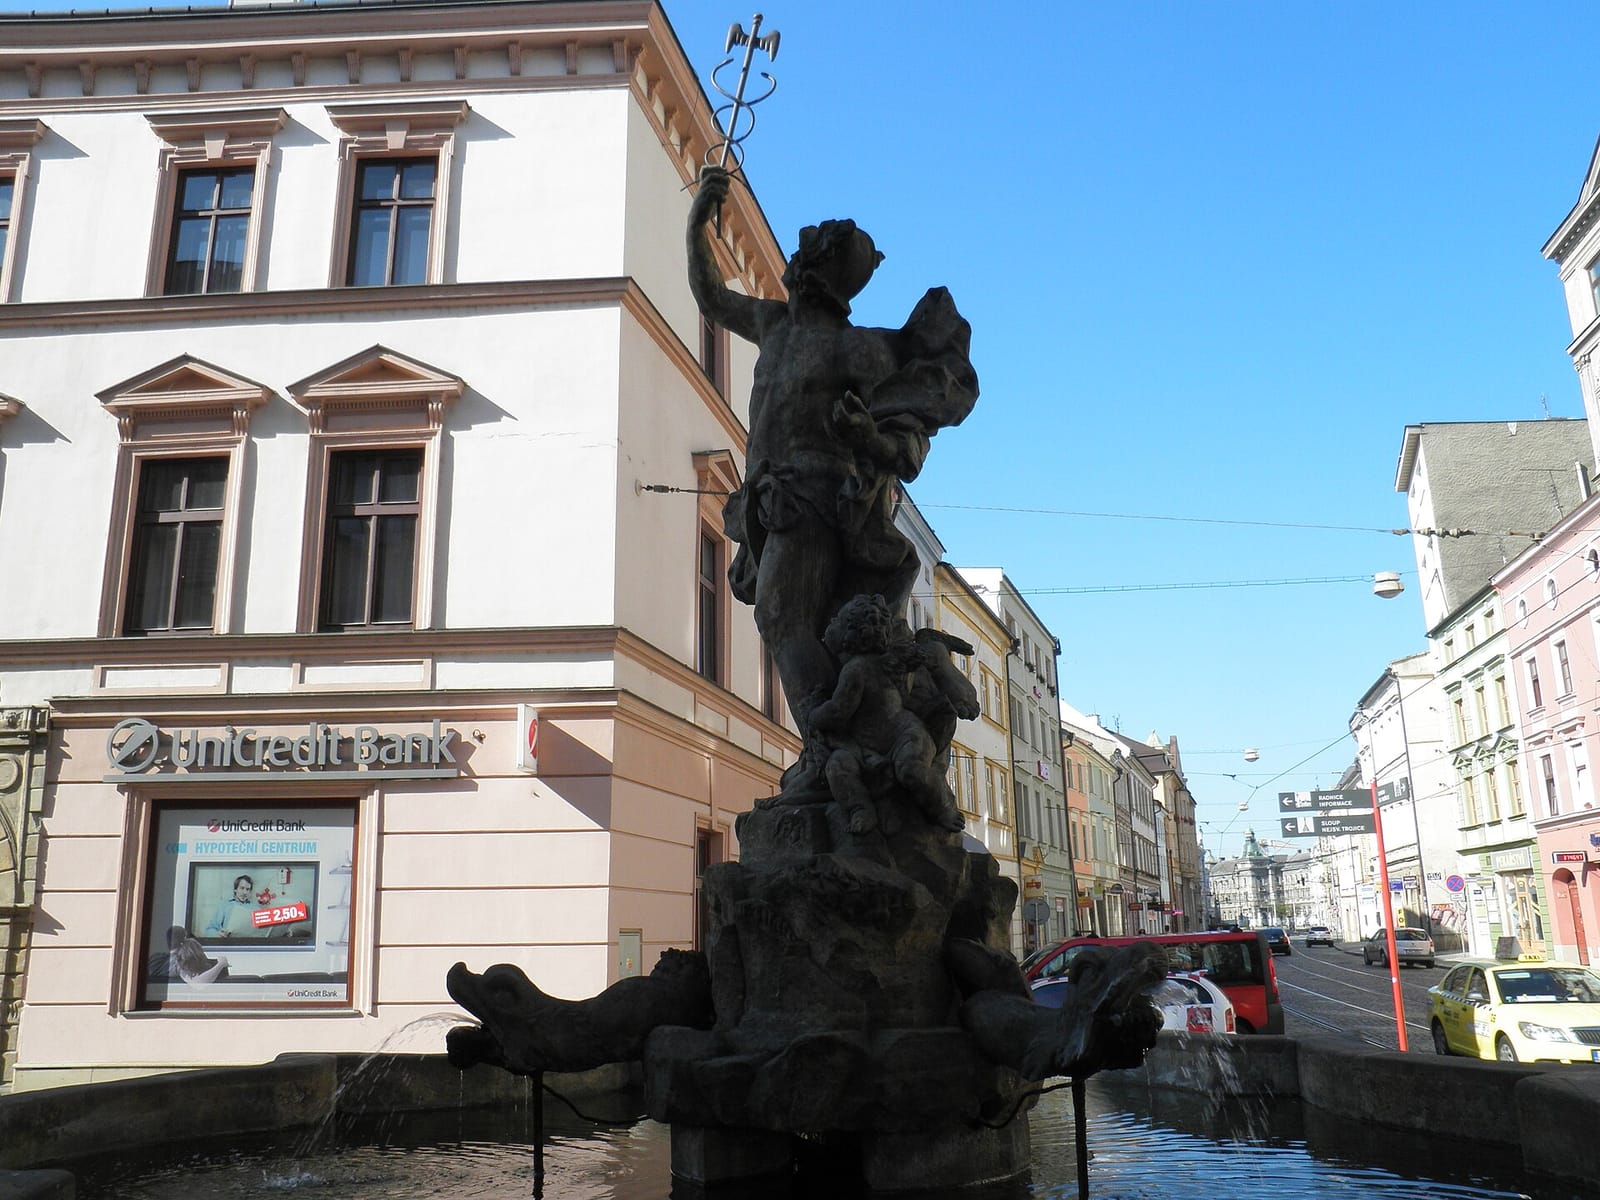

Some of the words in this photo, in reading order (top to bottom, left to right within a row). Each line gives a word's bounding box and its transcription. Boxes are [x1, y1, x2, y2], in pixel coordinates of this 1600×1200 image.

[171, 722, 343, 768] UniCredit
[353, 718, 457, 764] Bank
[222, 819, 274, 832] UniCredit
[277, 819, 305, 831] Bank
[195, 839, 258, 854] HYPOTEČNÍ
[262, 841, 317, 853] CENTRUM
[294, 990, 321, 998] UniCredit
